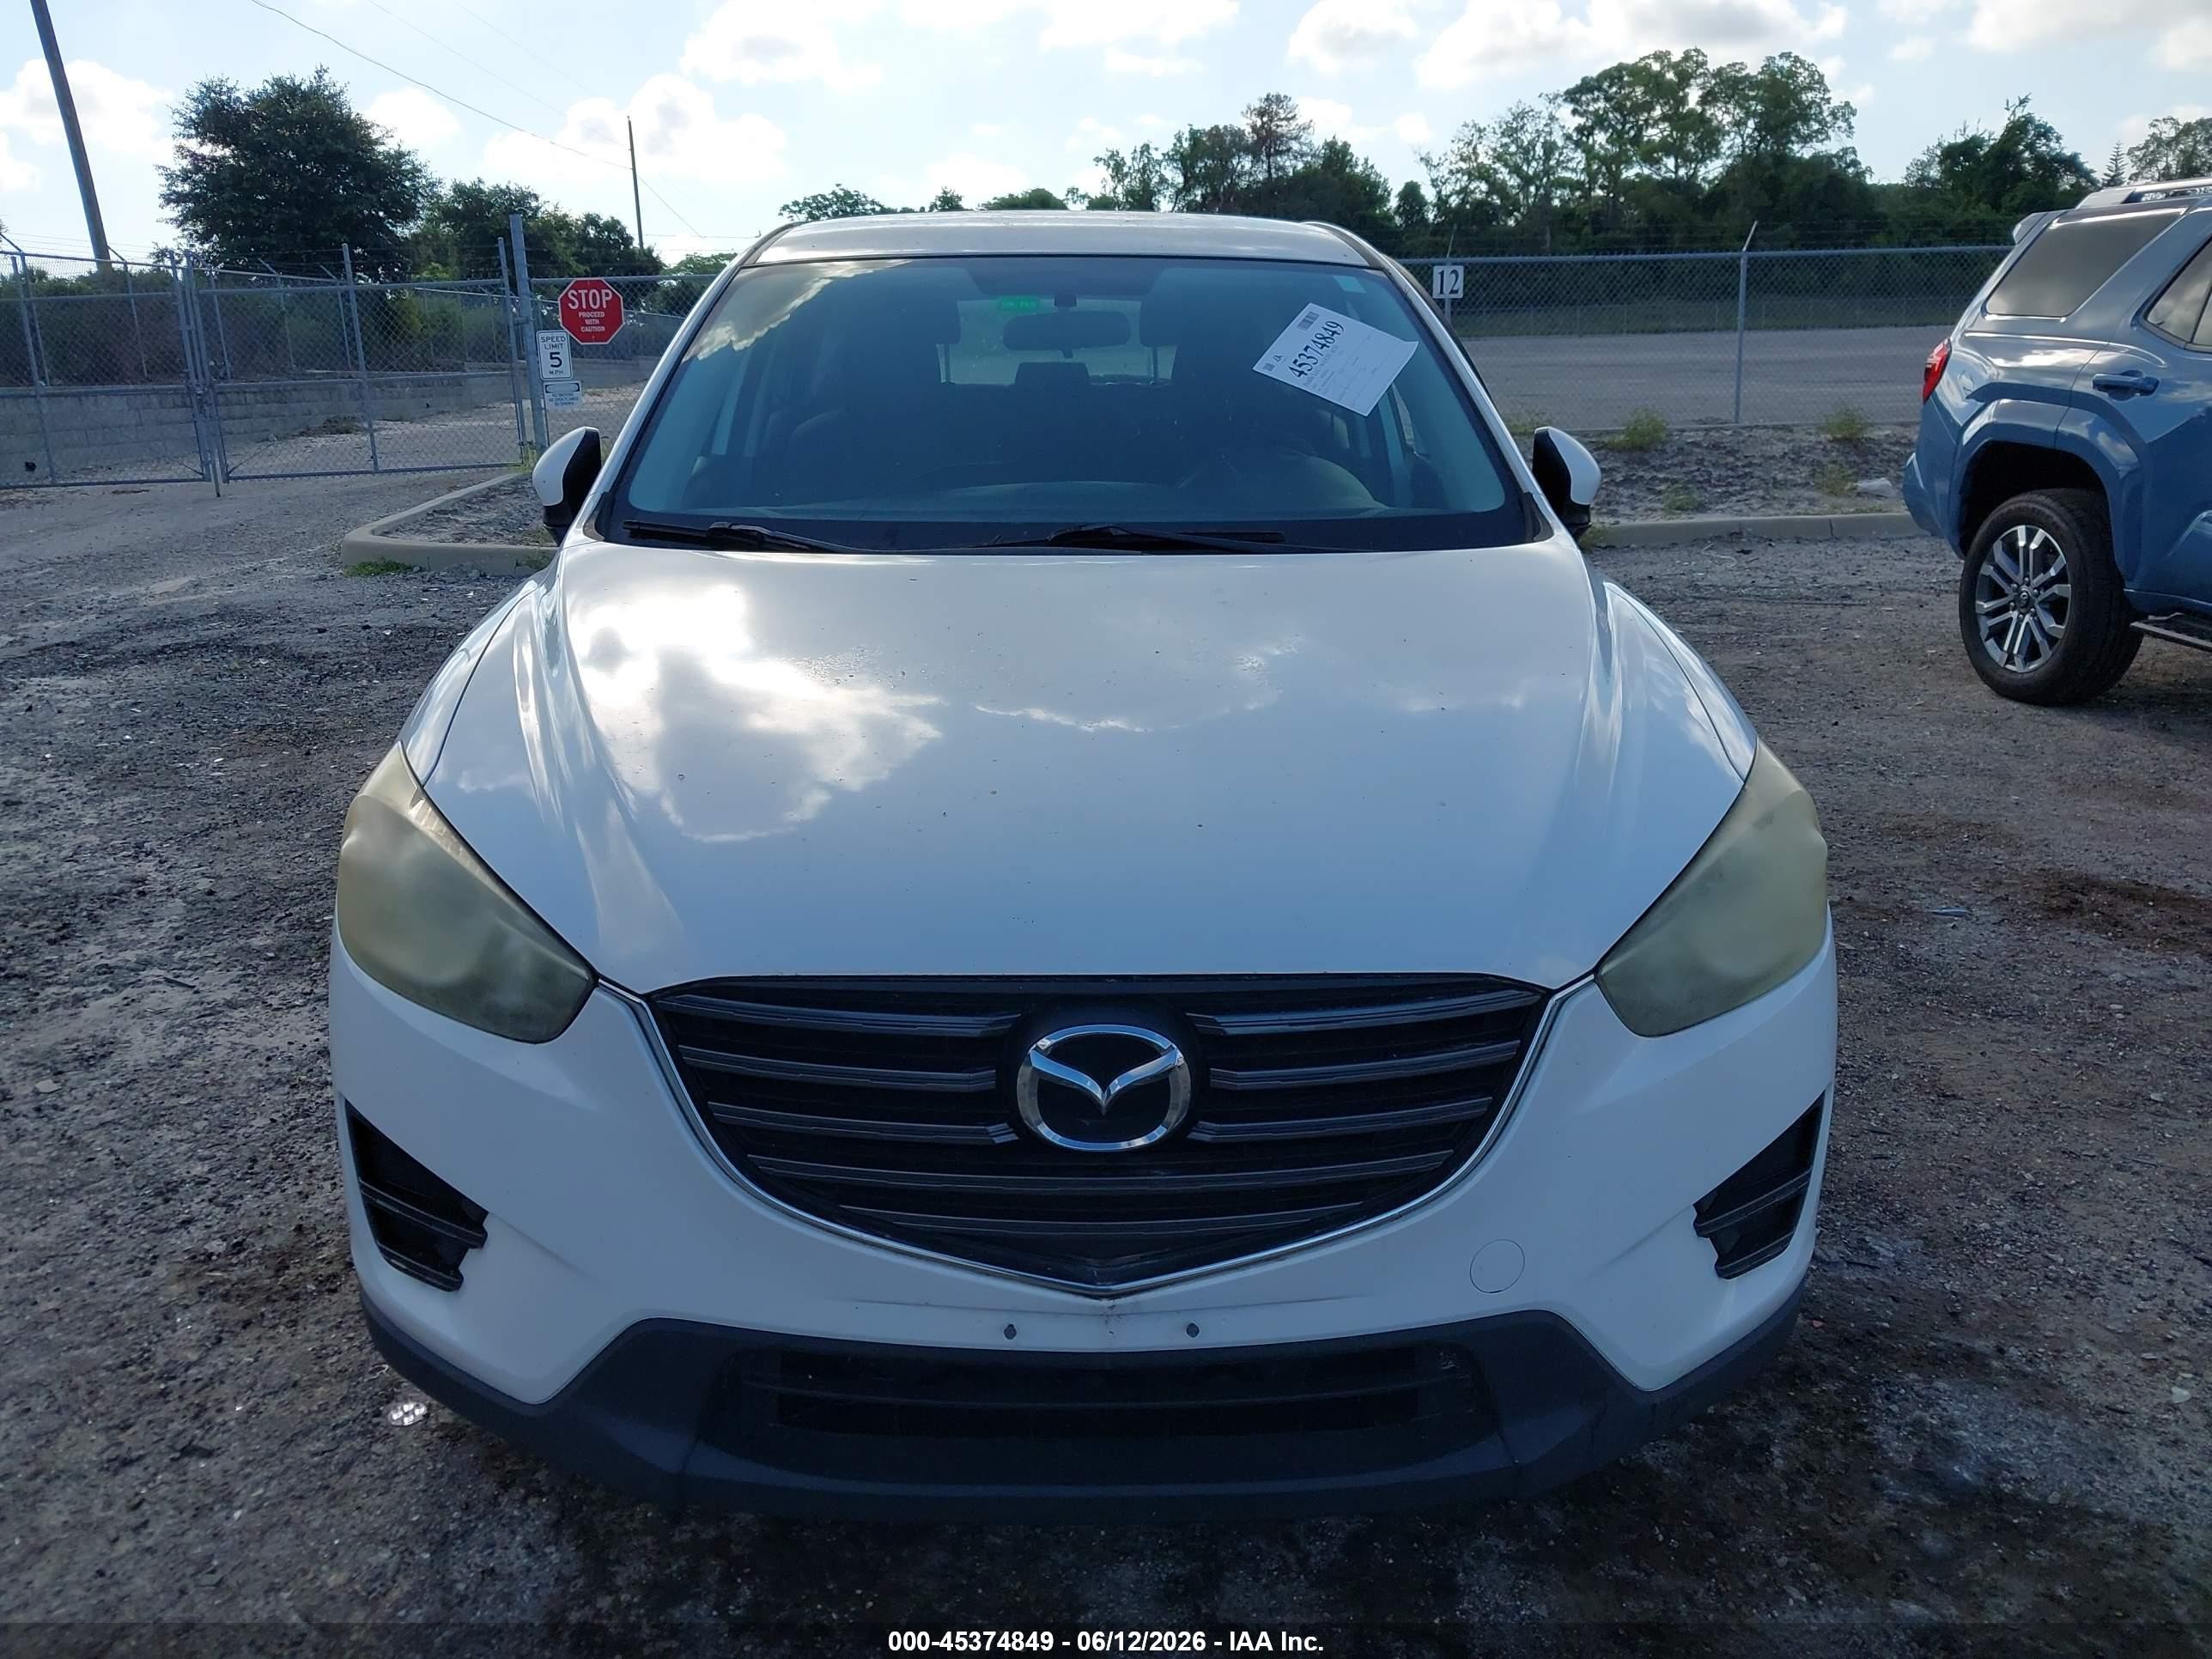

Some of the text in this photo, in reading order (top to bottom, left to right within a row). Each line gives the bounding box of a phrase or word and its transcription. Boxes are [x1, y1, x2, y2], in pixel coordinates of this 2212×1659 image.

[1437, 269, 1460, 295] 12
[568, 289, 612, 309] STOP
[550, 352, 562, 368] 5
[1288, 320, 1344, 378] 45374849
